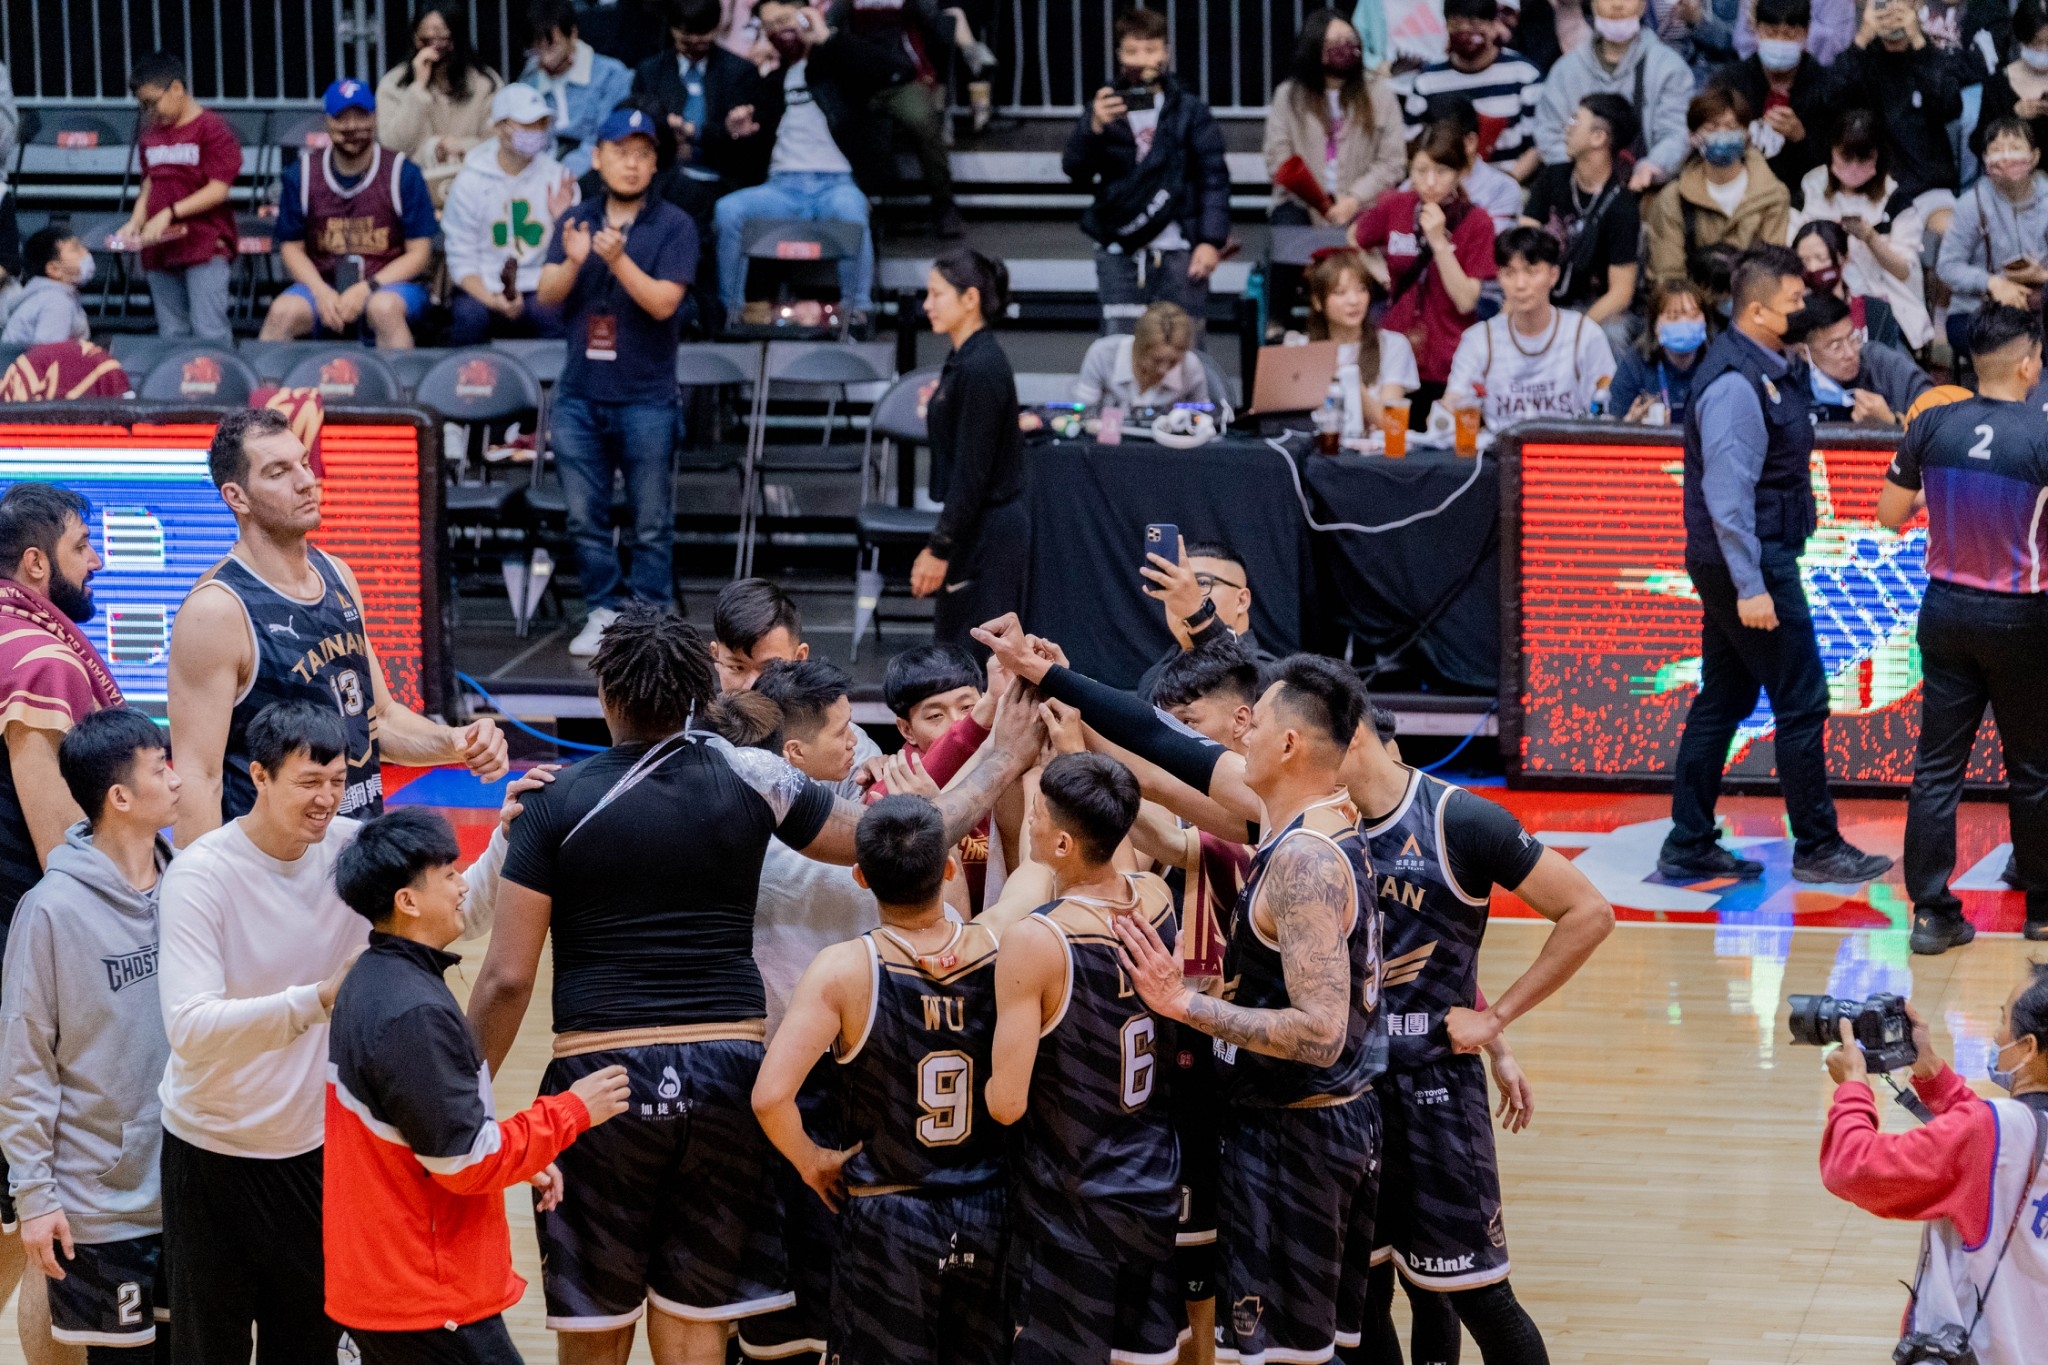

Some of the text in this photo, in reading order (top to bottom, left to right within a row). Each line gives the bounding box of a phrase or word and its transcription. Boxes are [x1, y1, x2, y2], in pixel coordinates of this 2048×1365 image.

[1968, 424, 1994, 460] 2
[291, 632, 368, 684] TAINAN
[329, 669, 364, 720] 13
[920, 994, 965, 1031] WU
[1120, 1010, 1157, 1114] 6
[916, 1049, 974, 1148] 9
[1424, 1088, 1449, 1098] TOYOTA
[1410, 1251, 1475, 1272] D-Link
[117, 1281, 143, 1326] 2
